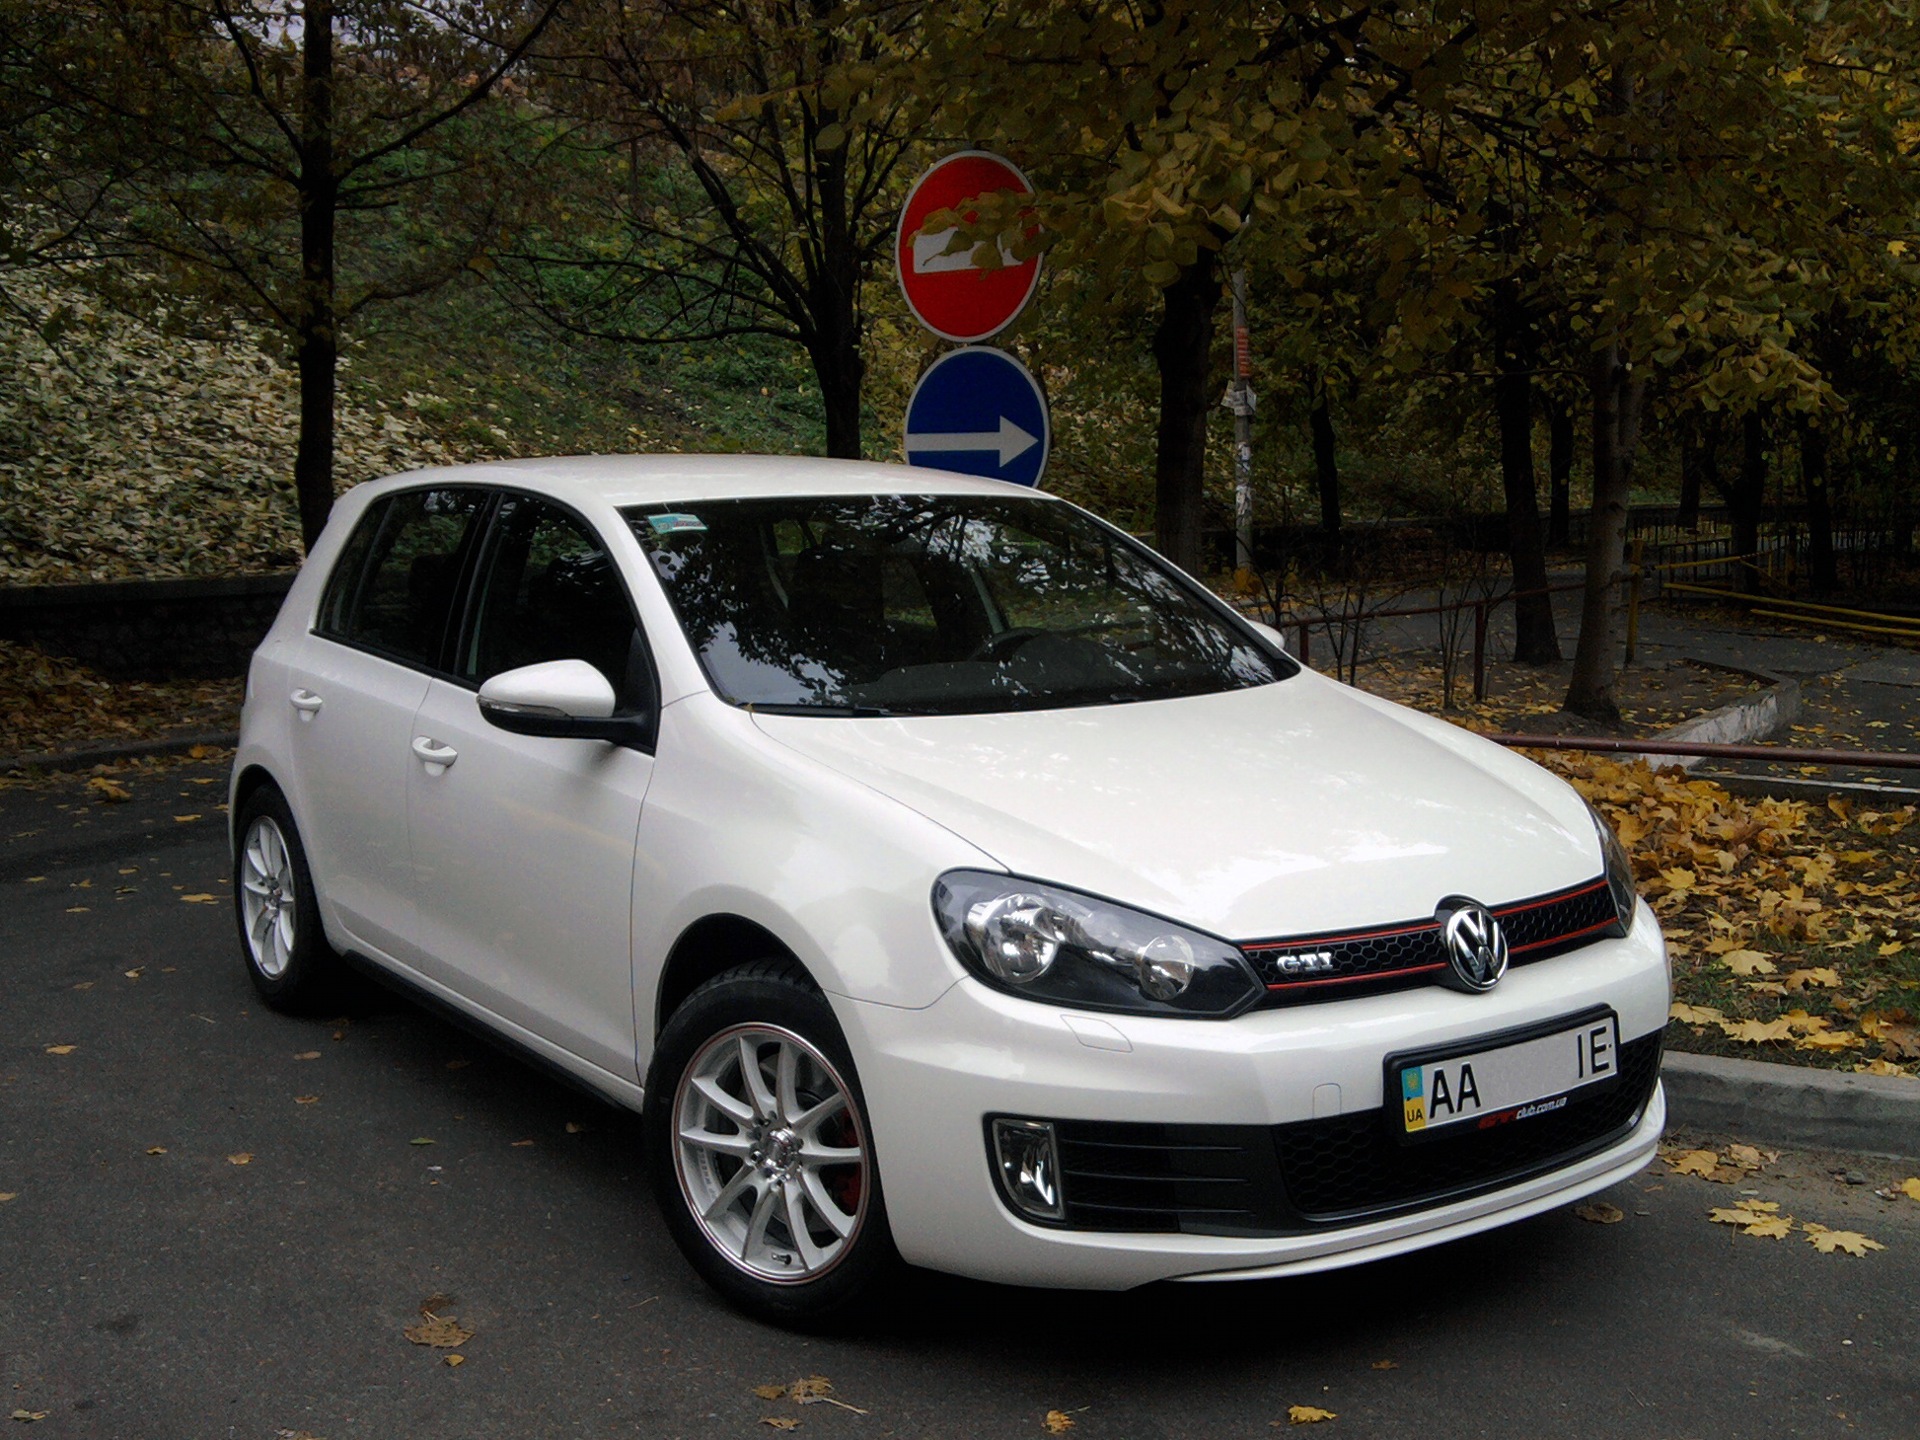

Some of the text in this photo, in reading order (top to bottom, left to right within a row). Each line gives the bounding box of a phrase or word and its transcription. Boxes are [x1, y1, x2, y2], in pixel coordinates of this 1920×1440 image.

[1276, 952, 1334, 974] GTI
[1429, 1026, 1610, 1119] AA IE
[1406, 1109, 1424, 1123] UA
